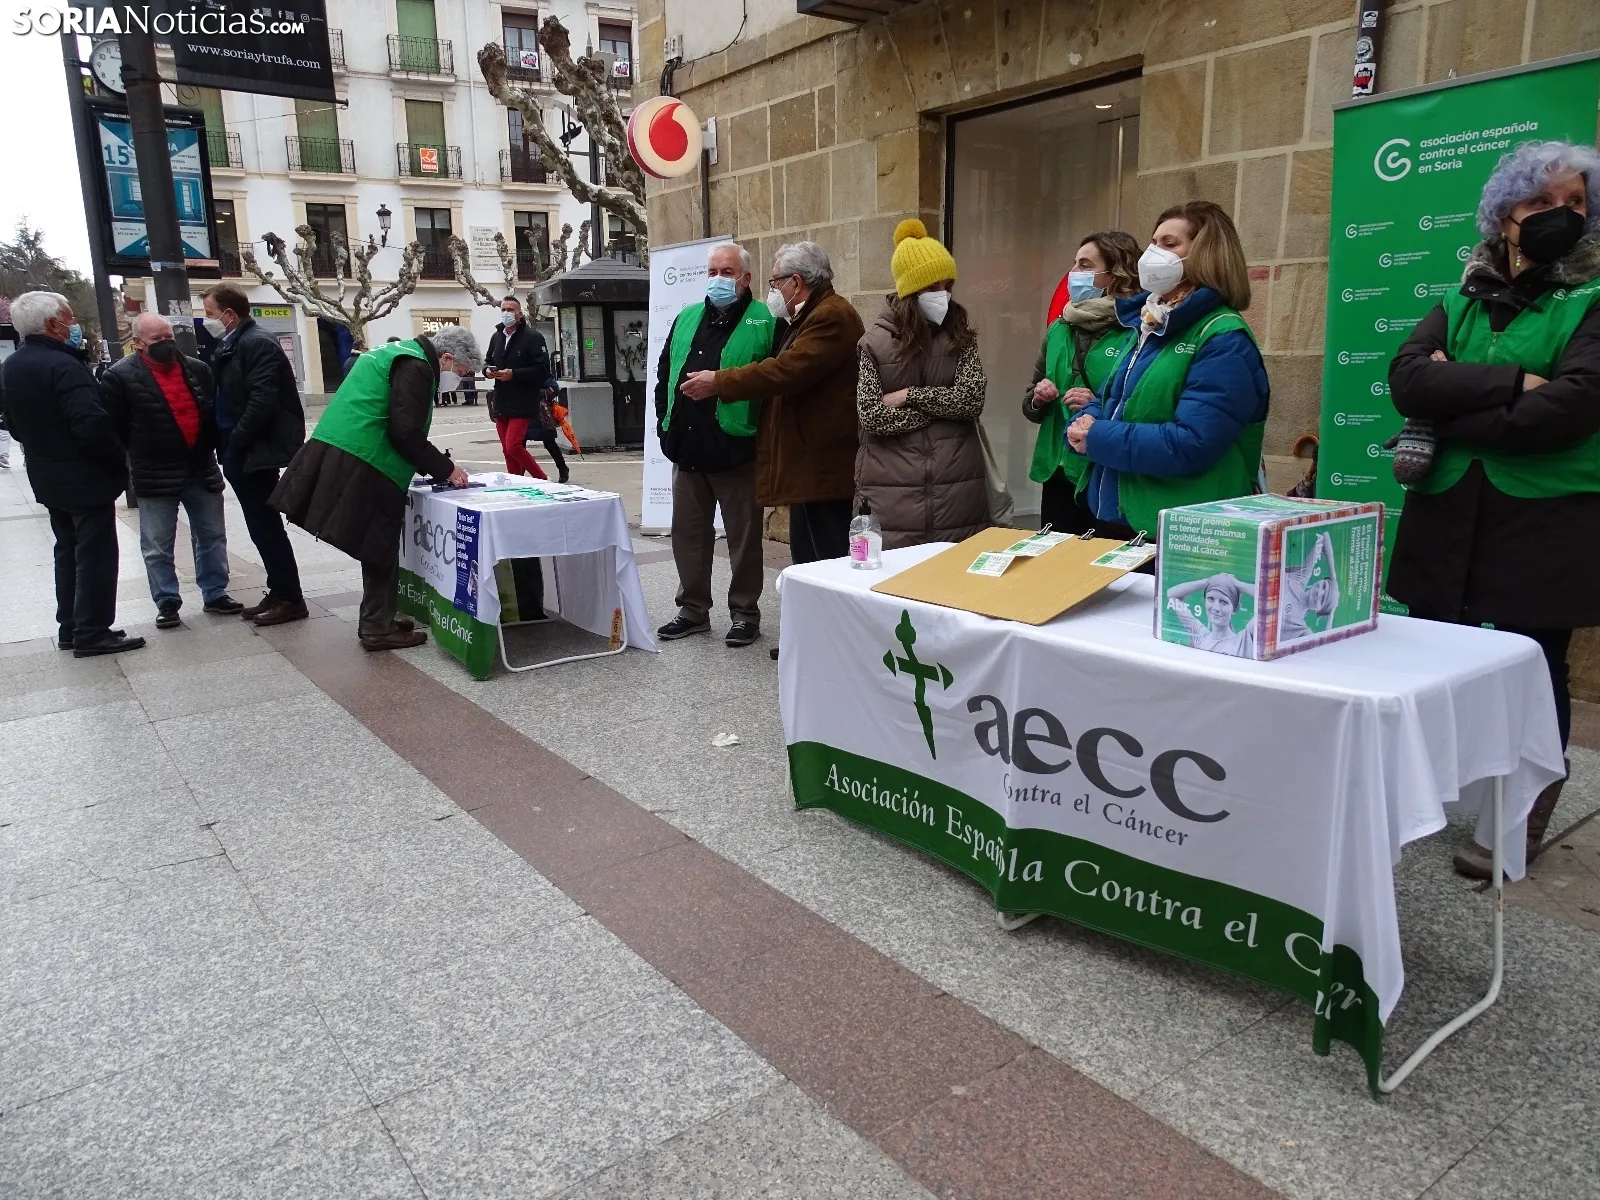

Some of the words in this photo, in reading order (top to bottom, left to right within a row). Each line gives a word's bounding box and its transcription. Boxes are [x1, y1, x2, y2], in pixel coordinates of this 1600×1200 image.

[187, 44, 321, 69] www.soriaytrufa.com
[1420, 130, 1480, 148] asociación
[1482, 121, 1538, 139] española
[1418, 147, 1455, 160] contra
[1457, 144, 1467, 155] el
[1470, 139, 1511, 152] cáncer
[1418, 163, 1432, 173] en
[1434, 159, 1462, 172] Soria
[1170, 514, 1177, 522] El
[1179, 515, 1201, 524] mejor
[1202, 518, 1231, 527] premio
[1180, 524, 1200, 534] tener
[1201, 524, 1212, 535] las
[1214, 528, 1246, 538] mismas
[1168, 533, 1220, 546] posibilidades
[1168, 542, 1191, 551] frente
[1200, 546, 1228, 556] cáncer
[1194, 605, 1202, 616] 9
[442, 615, 449, 630] el
[966, 694, 1230, 823] aecc
[1073, 794, 1091, 814] el
[1102, 802, 1189, 846] Cáncer
[824, 763, 936, 827] Asociación
[1064, 859, 1203, 930] Contra
[1224, 912, 1258, 948] el
